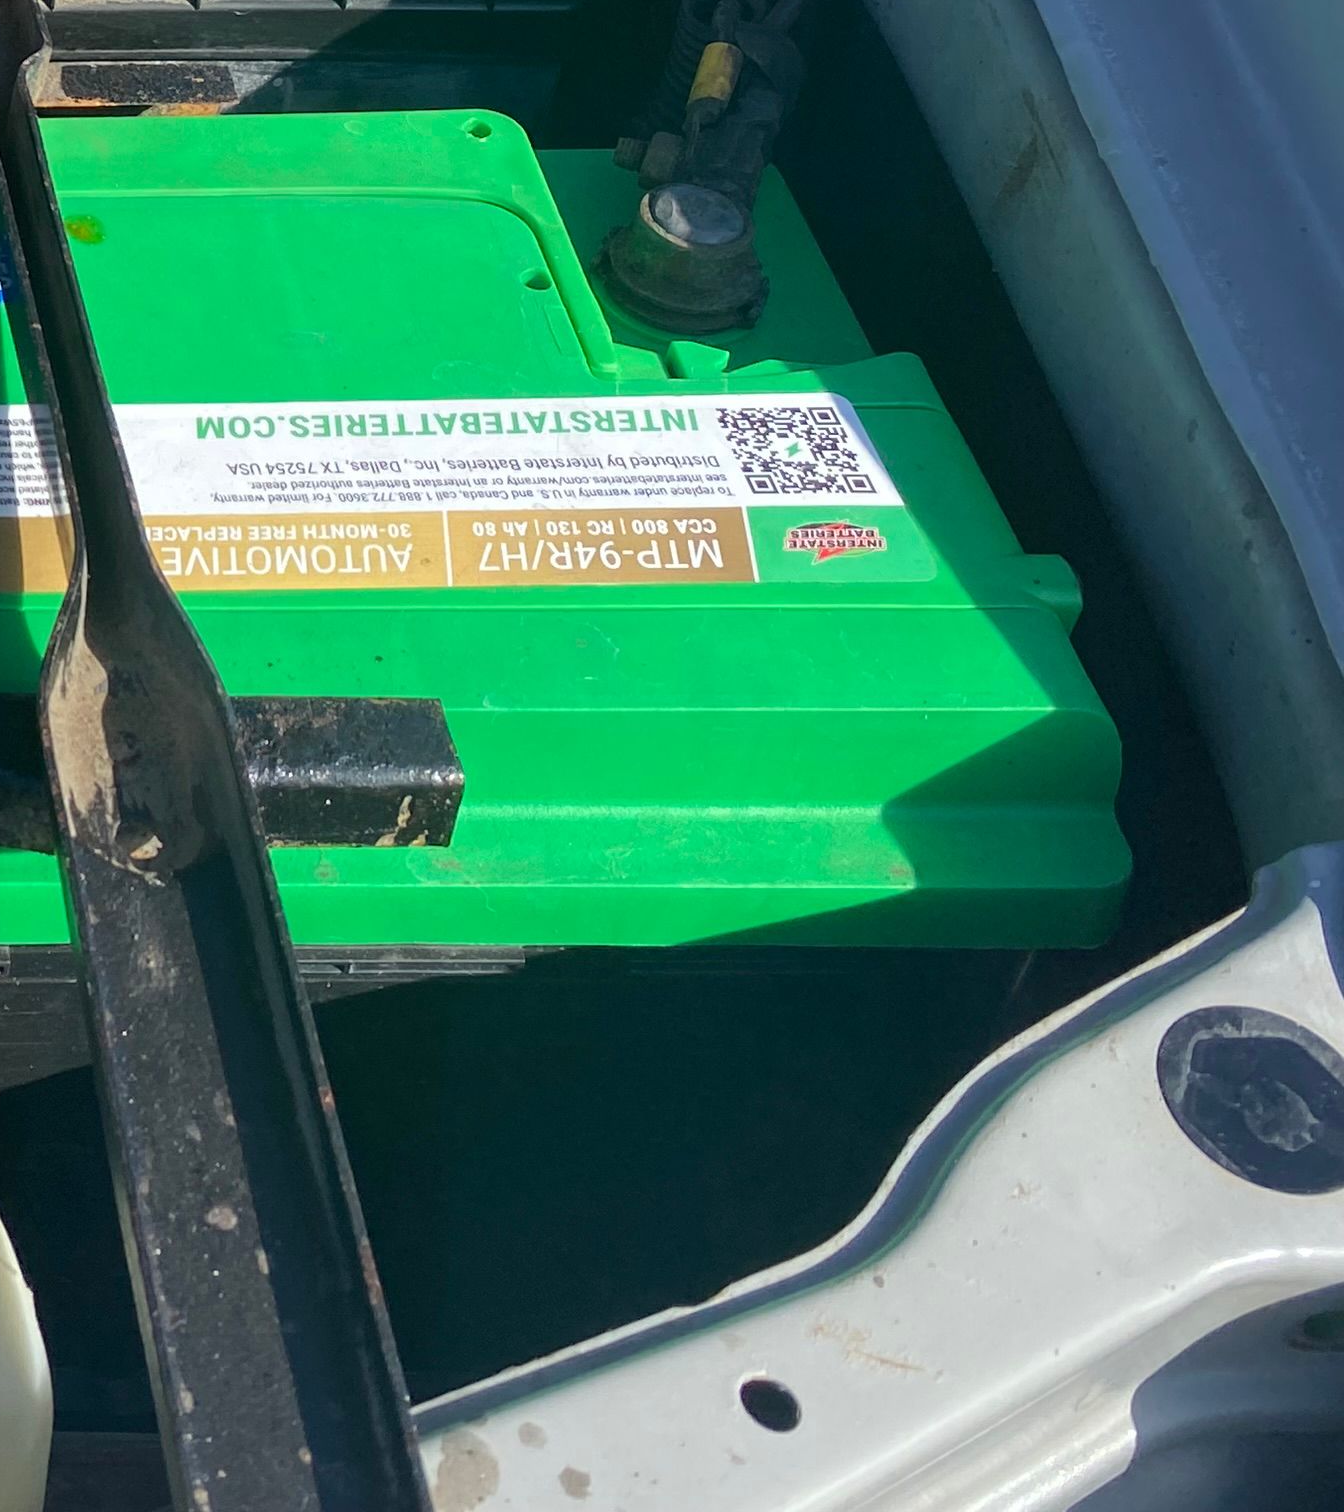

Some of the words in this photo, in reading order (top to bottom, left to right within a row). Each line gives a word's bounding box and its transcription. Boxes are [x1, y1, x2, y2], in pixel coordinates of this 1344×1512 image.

[196, 408, 699, 439] INTERSTATEBATTERIES.COM
[266, 462, 315, 474] 75254
[321, 462, 344, 473] TX
[346, 460, 401, 473] Dallas,
[404, 458, 439, 472] Inc.,
[442, 458, 520, 470] Batteries,
[525, 457, 602, 470] Interstate
[608, 455, 625, 469] by
[630, 455, 720, 469] Distributed
[226, 462, 262, 475] USA
[413, 478, 471, 488] Interstate
[474, 478, 488, 486] an
[507, 474, 702, 486] interstatebatteries.com/warranty
[706, 473, 727, 482] see
[247, 481, 287, 491] dealer.
[291, 480, 353, 491] authorized
[357, 479, 409, 489] Batteries
[334, 491, 432, 503] 1.888.772.3600.
[435, 491, 457, 500] call
[460, 489, 508, 499] Canada,
[512, 489, 534, 499] and
[538, 489, 561, 499] U.S.
[565, 489, 576, 499] in
[579, 487, 631, 498] warranty
[634, 487, 666, 497] under
[671, 485, 715, 497] replace
[719, 486, 734, 496] To
[210, 493, 265, 504] warranty,
[269, 494, 308, 504] limited
[312, 493, 331, 503] For
[248, 525, 297, 540] FREE
[303, 523, 412, 539] 30-MONTH
[472, 521, 497, 536] 80
[502, 521, 528, 536] Ah
[546, 520, 580, 536] 130
[585, 520, 613, 536] RC
[632, 518, 668, 535] 800
[673, 518, 716, 535] CCA
[145, 526, 242, 542] REPLACE
[789, 529, 875, 539] BATTERIES
[786, 538, 884, 549] INTERSTATE
[160, 543, 413, 575] AUTOMOTIVE
[479, 538, 723, 571] MTP-94R/H7
